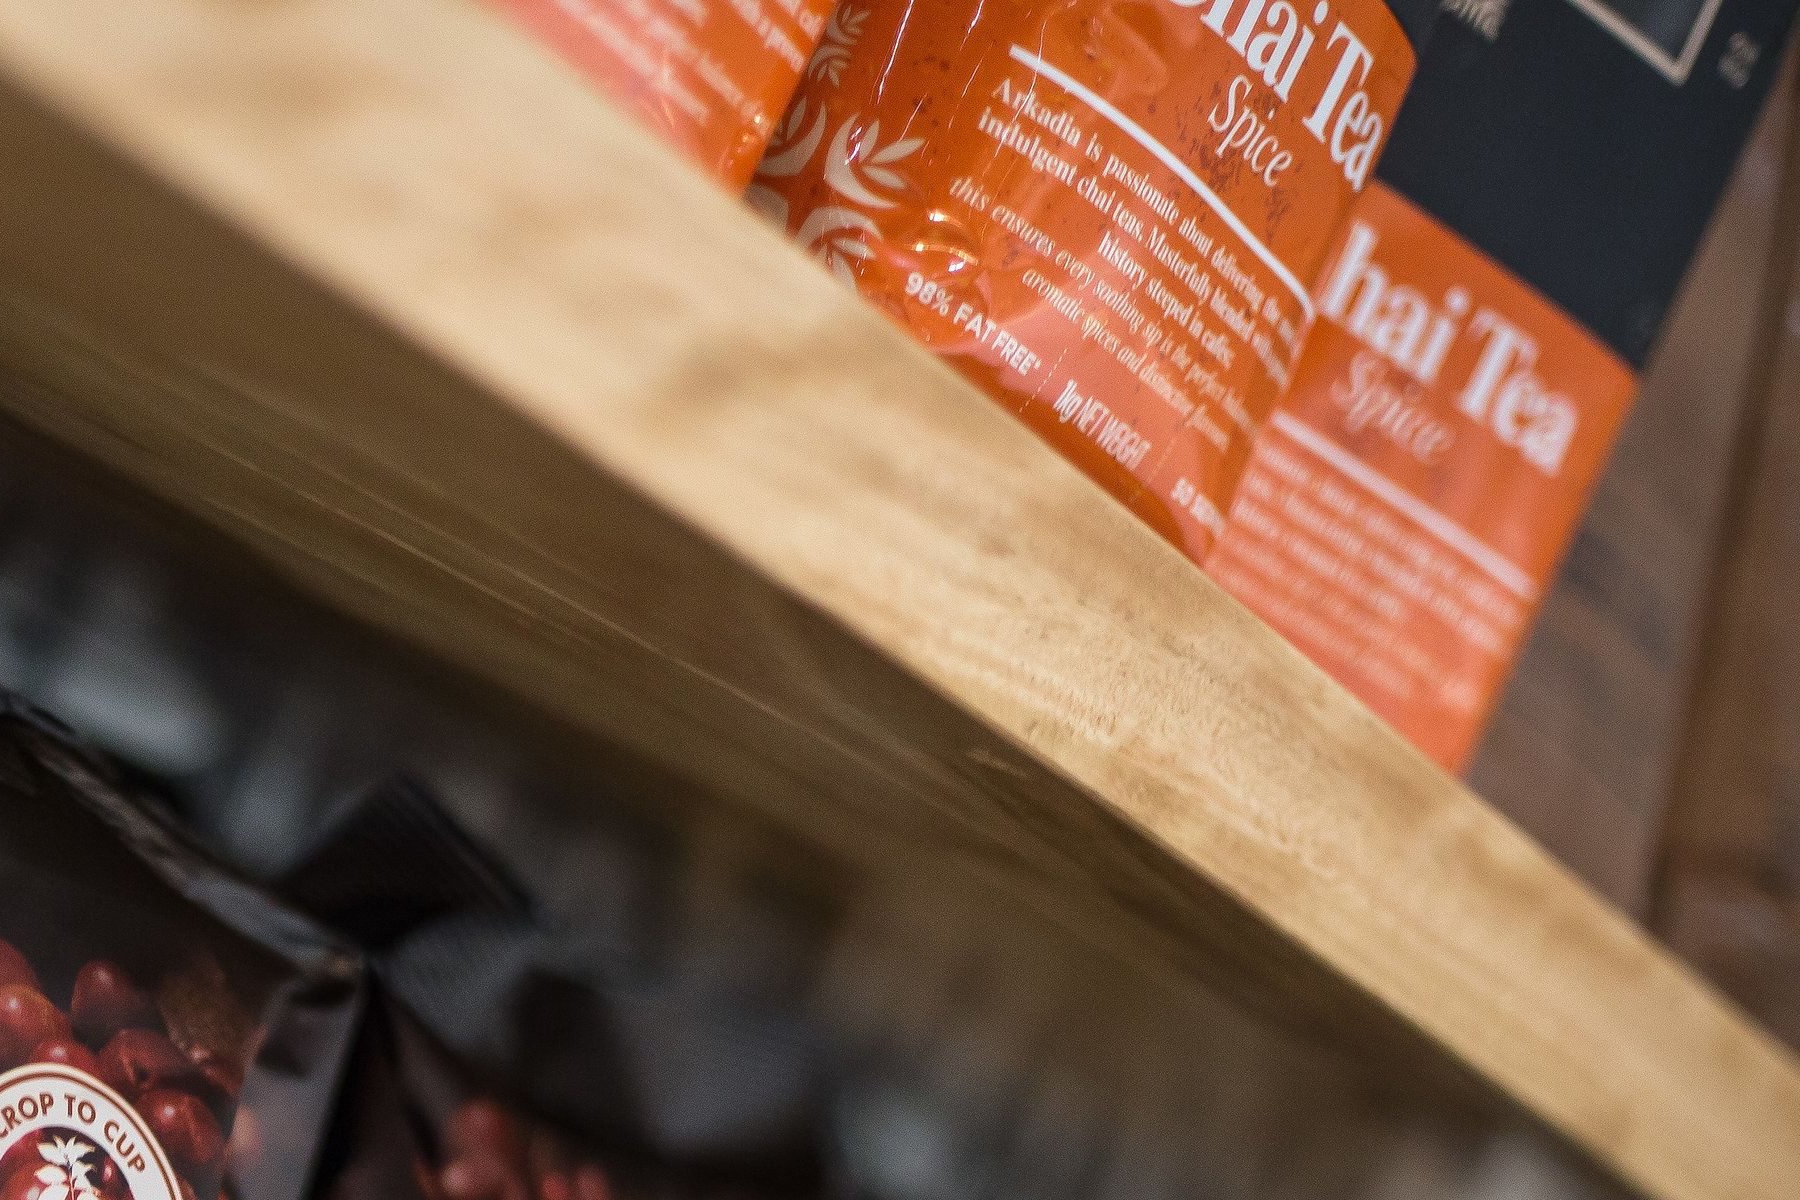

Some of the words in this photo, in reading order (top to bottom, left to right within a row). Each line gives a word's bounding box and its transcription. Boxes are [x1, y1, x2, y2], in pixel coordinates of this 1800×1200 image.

[1207, 74, 1293, 188] Spice
[1302, 20, 1383, 192] Tea
[978, 106, 1079, 187] indulgent
[1076, 175, 1117, 214] chai
[1146, 224, 1212, 307] Masterfully
[991, 78, 1082, 148] Arkadia
[1085, 132, 1103, 162] is
[1102, 153, 1180, 225] passionate
[1178, 216, 1213, 259] about
[904, 271, 953, 317] 98%
[952, 302, 997, 343] FAT
[950, 176, 991, 212] this
[990, 204, 1056, 258] ensures
[1055, 249, 1096, 291] every
[1092, 277, 1145, 335] soothing
[1142, 320, 1163, 348] sip
[1098, 230, 1149, 291] history
[1145, 276, 1194, 328] steeped
[1022, 268, 1086, 325] aromatic
[1080, 312, 1122, 354] spices
[1117, 347, 1148, 375] and
[1073, 395, 1110, 438] NET
[1457, 308, 1578, 478] Tea
[63, 1094, 97, 1126] TO
[103, 1118, 147, 1174] CUP
